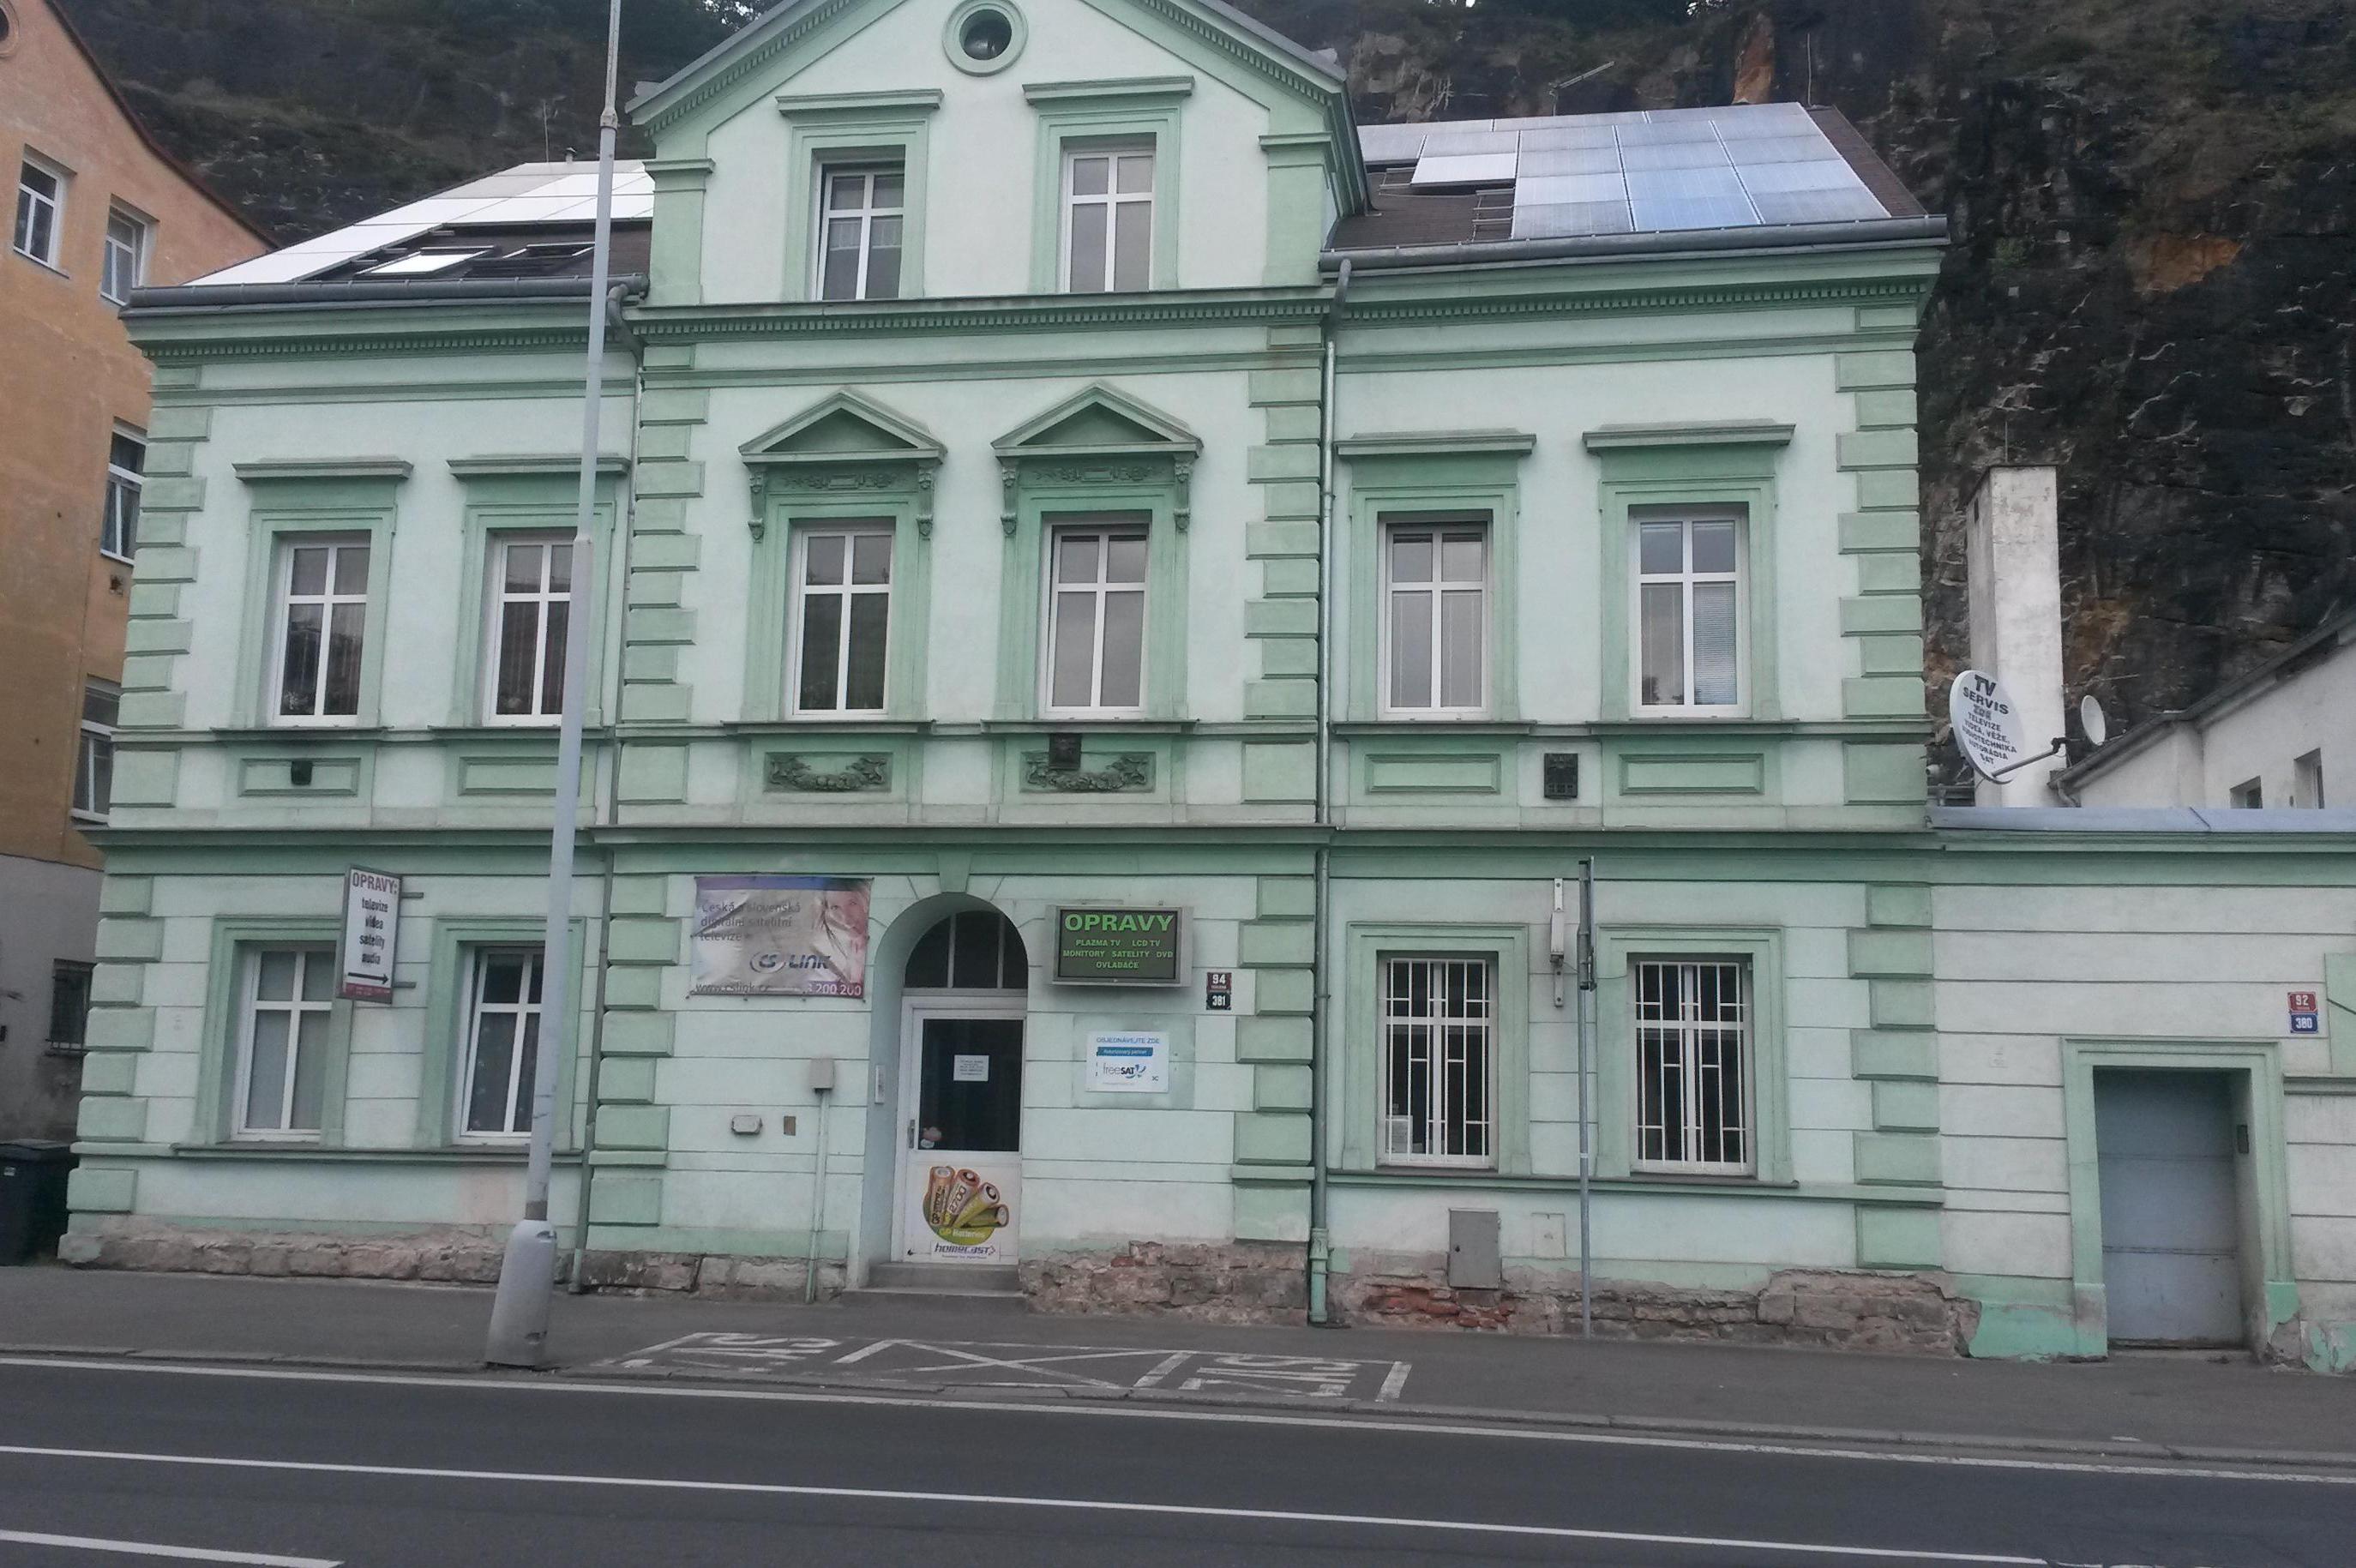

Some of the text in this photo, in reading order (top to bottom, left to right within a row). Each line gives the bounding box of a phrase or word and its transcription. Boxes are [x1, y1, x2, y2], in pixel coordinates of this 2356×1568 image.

[1974, 674, 1997, 697] TV
[1963, 687, 2009, 715] SERVIS
[1968, 712, 2001, 731] TELEVIZE
[352, 872, 398, 895] OPRAVY:
[362, 898, 388, 913] televize
[365, 916, 384, 930] videa
[1064, 913, 1175, 931] OPRAVY
[358, 934, 385, 950] satelity
[1212, 974, 1226, 984] 94
[816, 983, 837, 994] 200
[839, 984, 862, 996] 200
[1212, 995, 1226, 1006] 381
[2295, 994, 2309, 1006] 92
[2295, 1017, 2312, 1029] 380
